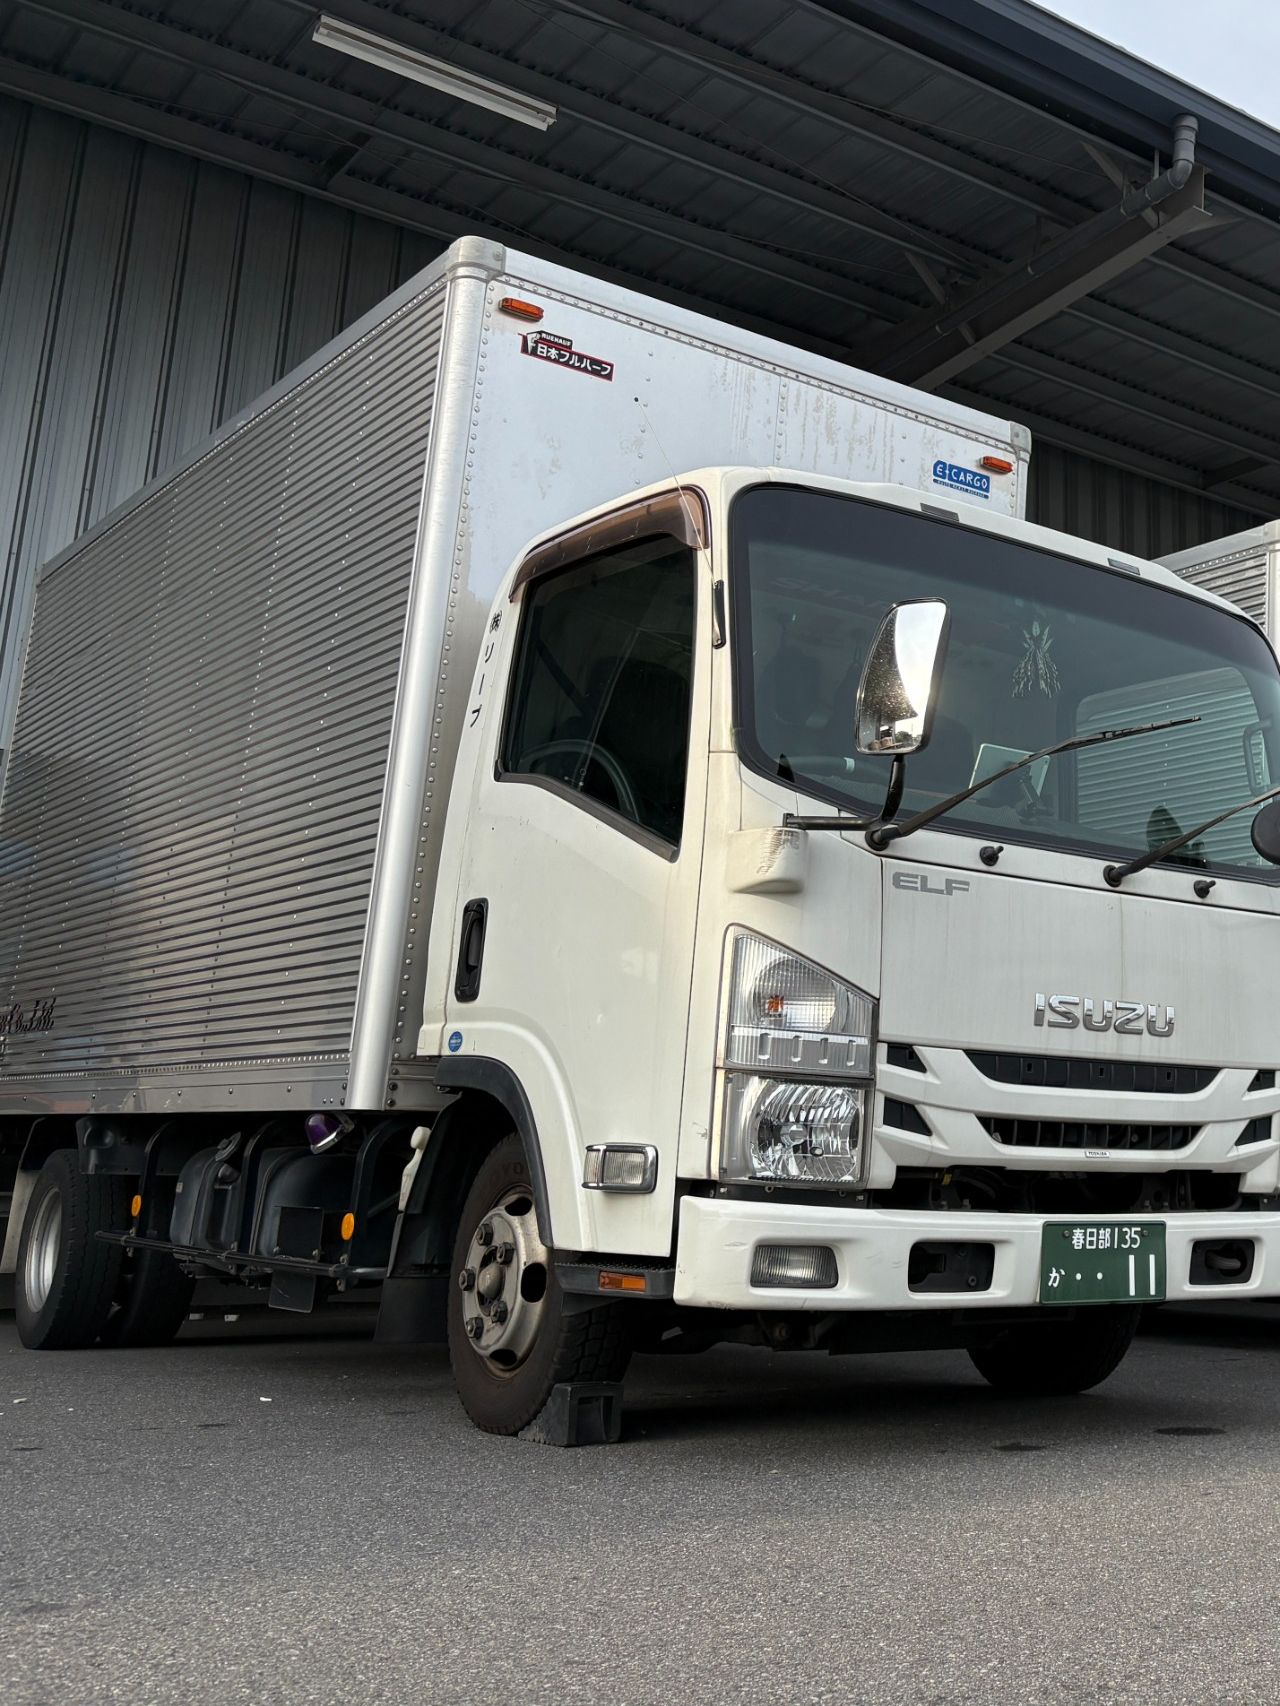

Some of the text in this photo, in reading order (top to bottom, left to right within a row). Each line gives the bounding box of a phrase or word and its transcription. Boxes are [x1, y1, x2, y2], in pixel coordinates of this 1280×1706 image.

[537, 343, 611, 375] 日本フルハーフ
[892, 871, 970, 896] ELF
[1033, 992, 1175, 1037] ISUZU
